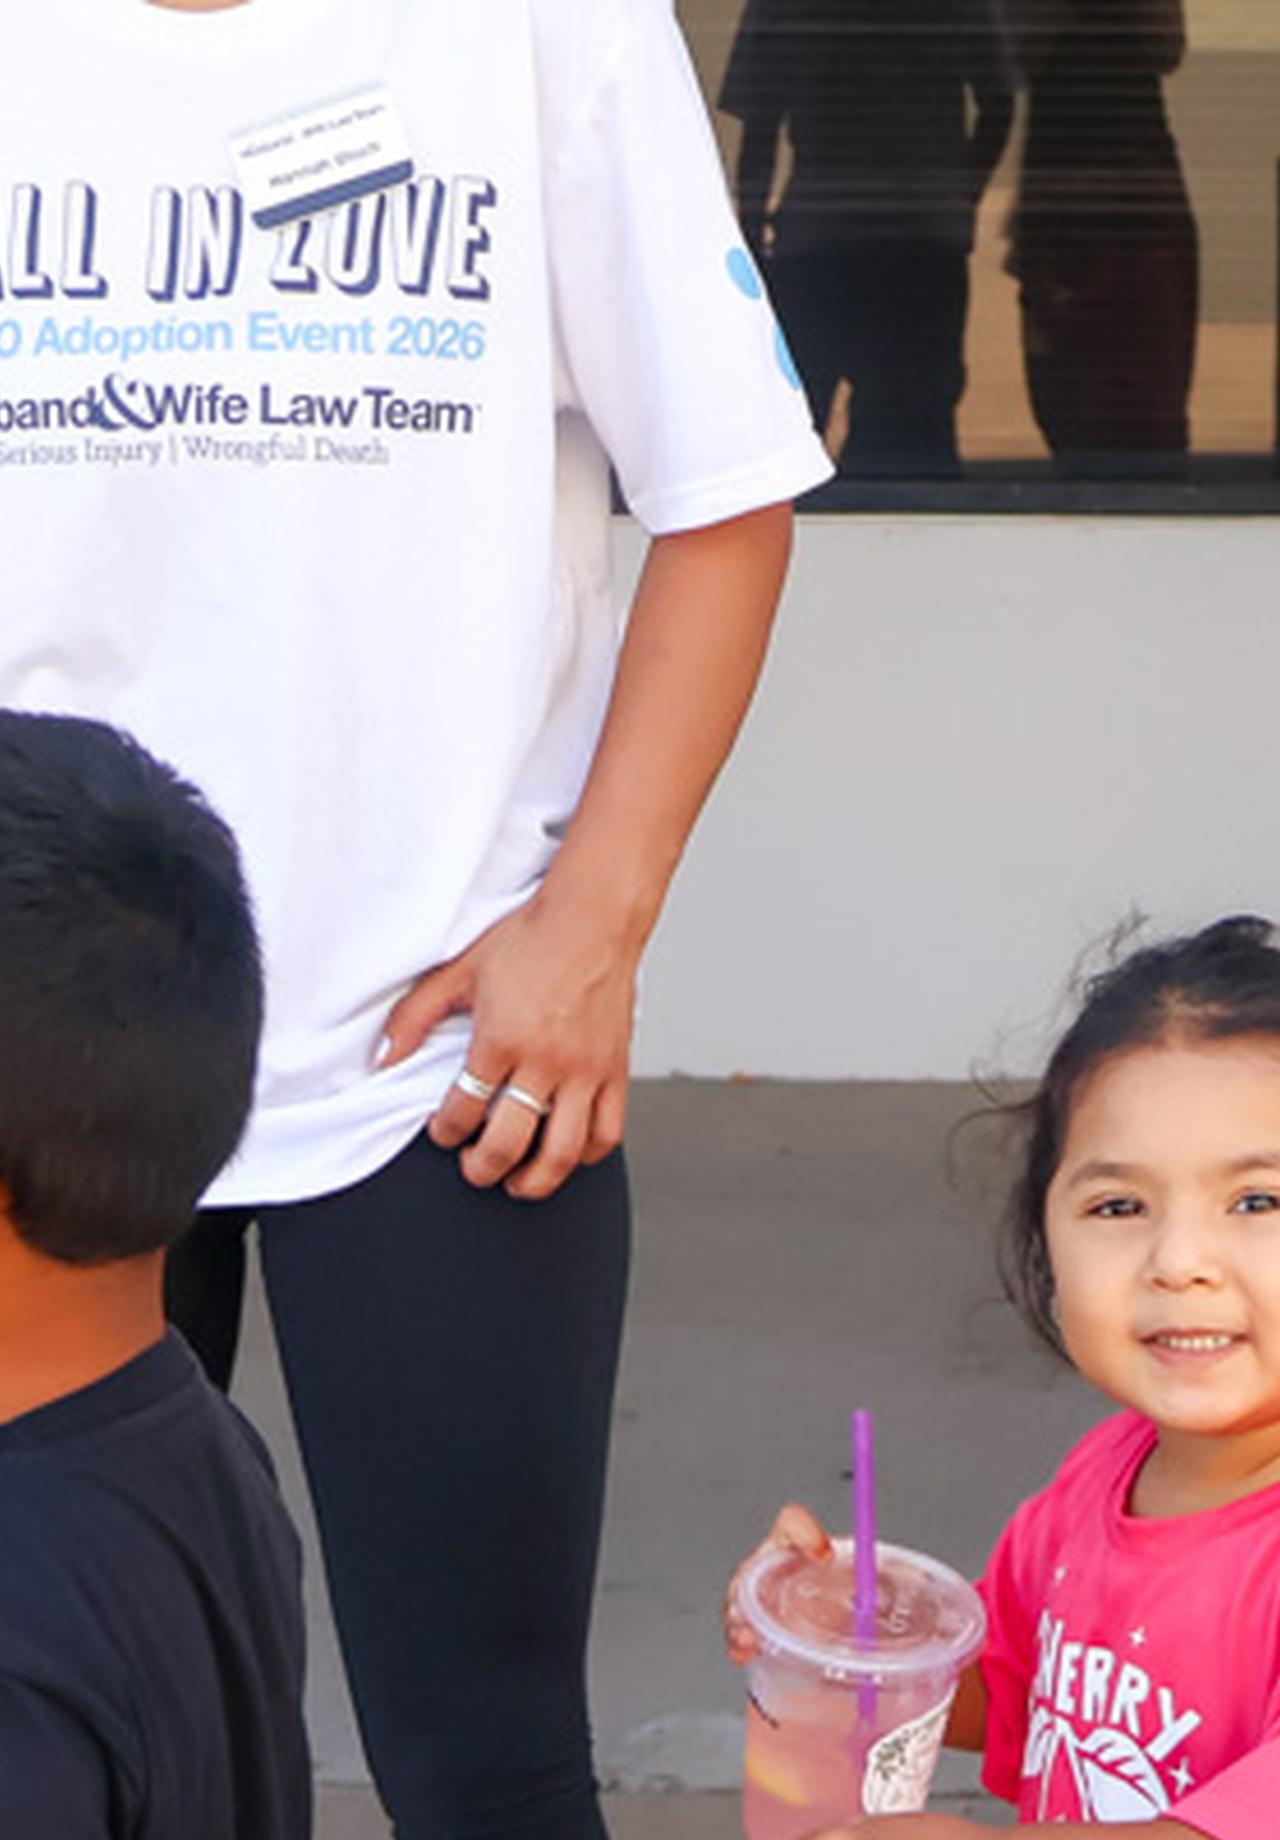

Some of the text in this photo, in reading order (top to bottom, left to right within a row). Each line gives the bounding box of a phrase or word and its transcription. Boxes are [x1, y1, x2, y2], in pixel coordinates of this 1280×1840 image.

[146, 184, 242, 303] IN
[33, 316, 233, 362] Adoption
[248, 311, 376, 353] Event
[387, 315, 487, 360] 2026
[260, 383, 358, 427] Law
[362, 386, 474, 434] Team
[84, 436, 162, 467] Injury
[183, 432, 306, 467] Wrongful
[1027, 1608, 1203, 1763] HERRY
